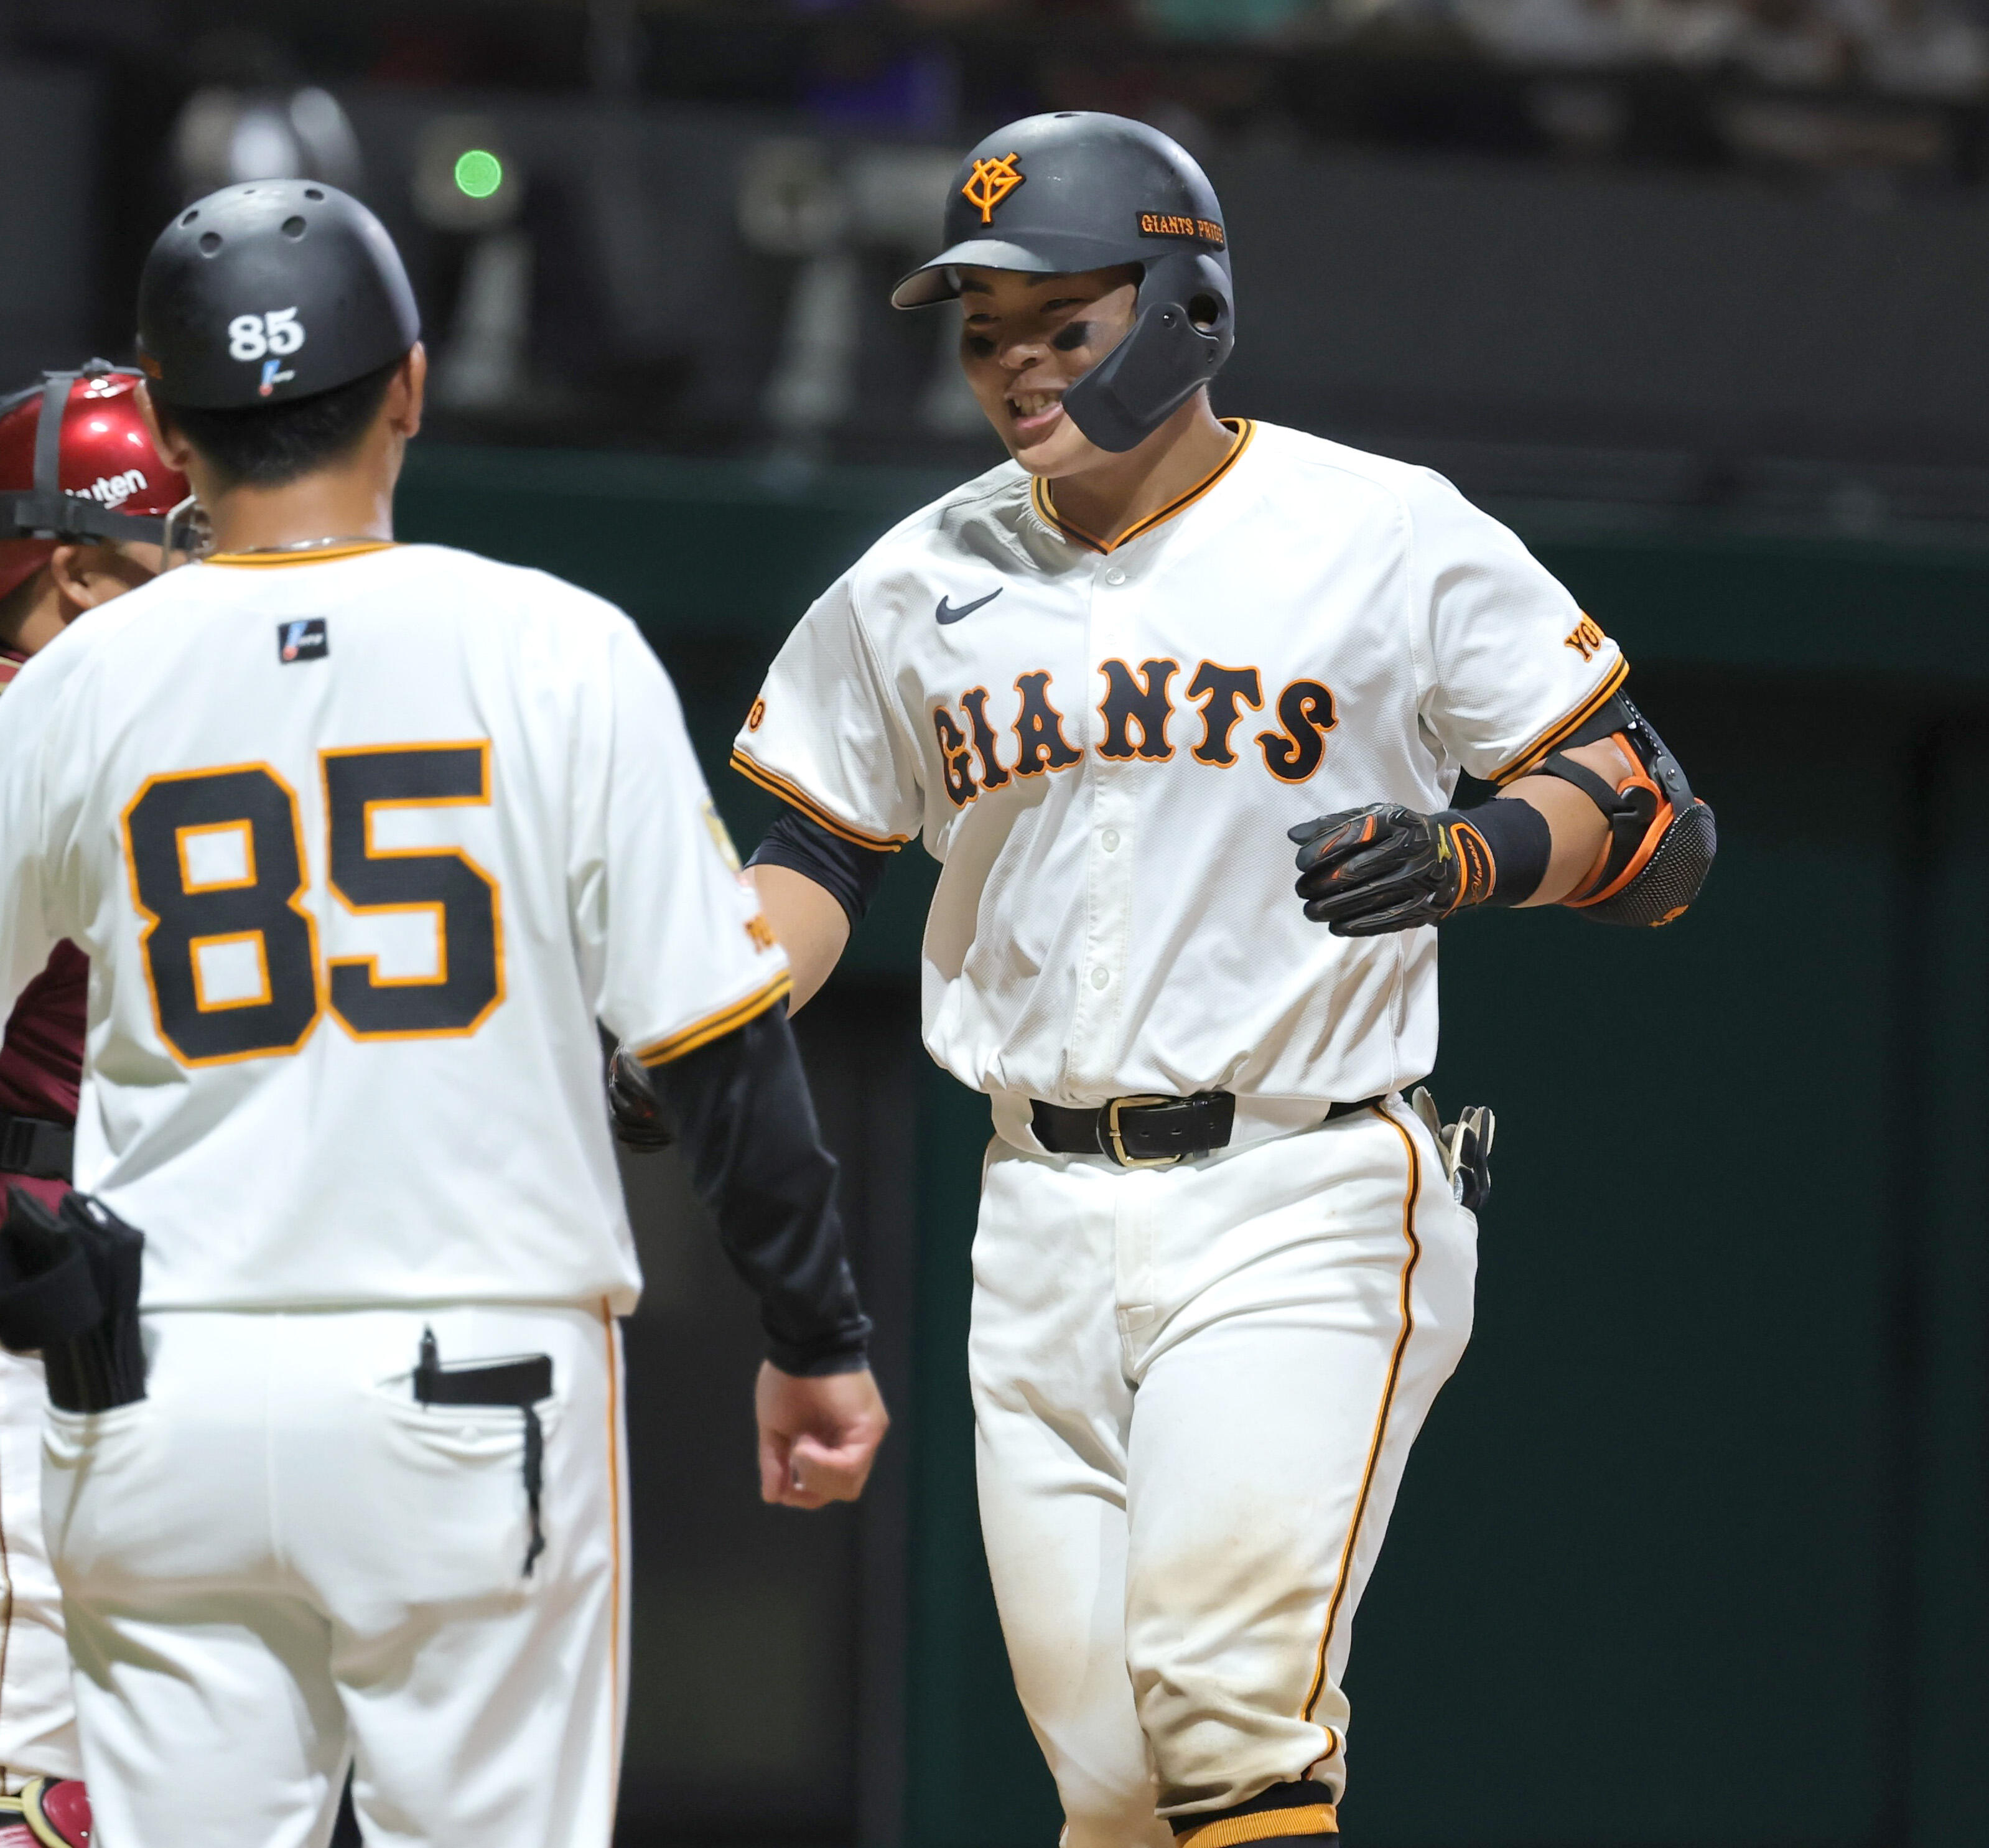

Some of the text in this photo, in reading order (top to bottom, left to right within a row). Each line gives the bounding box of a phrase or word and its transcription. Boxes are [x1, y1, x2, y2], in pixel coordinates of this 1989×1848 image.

[1141, 214, 1224, 244] GIANTS PRIDE
[228, 306, 306, 362] 85
[63, 468, 148, 503] uten
[1563, 610, 1606, 663] YO
[933, 657, 1339, 809] GIANTS
[119, 738, 507, 1070] 85
